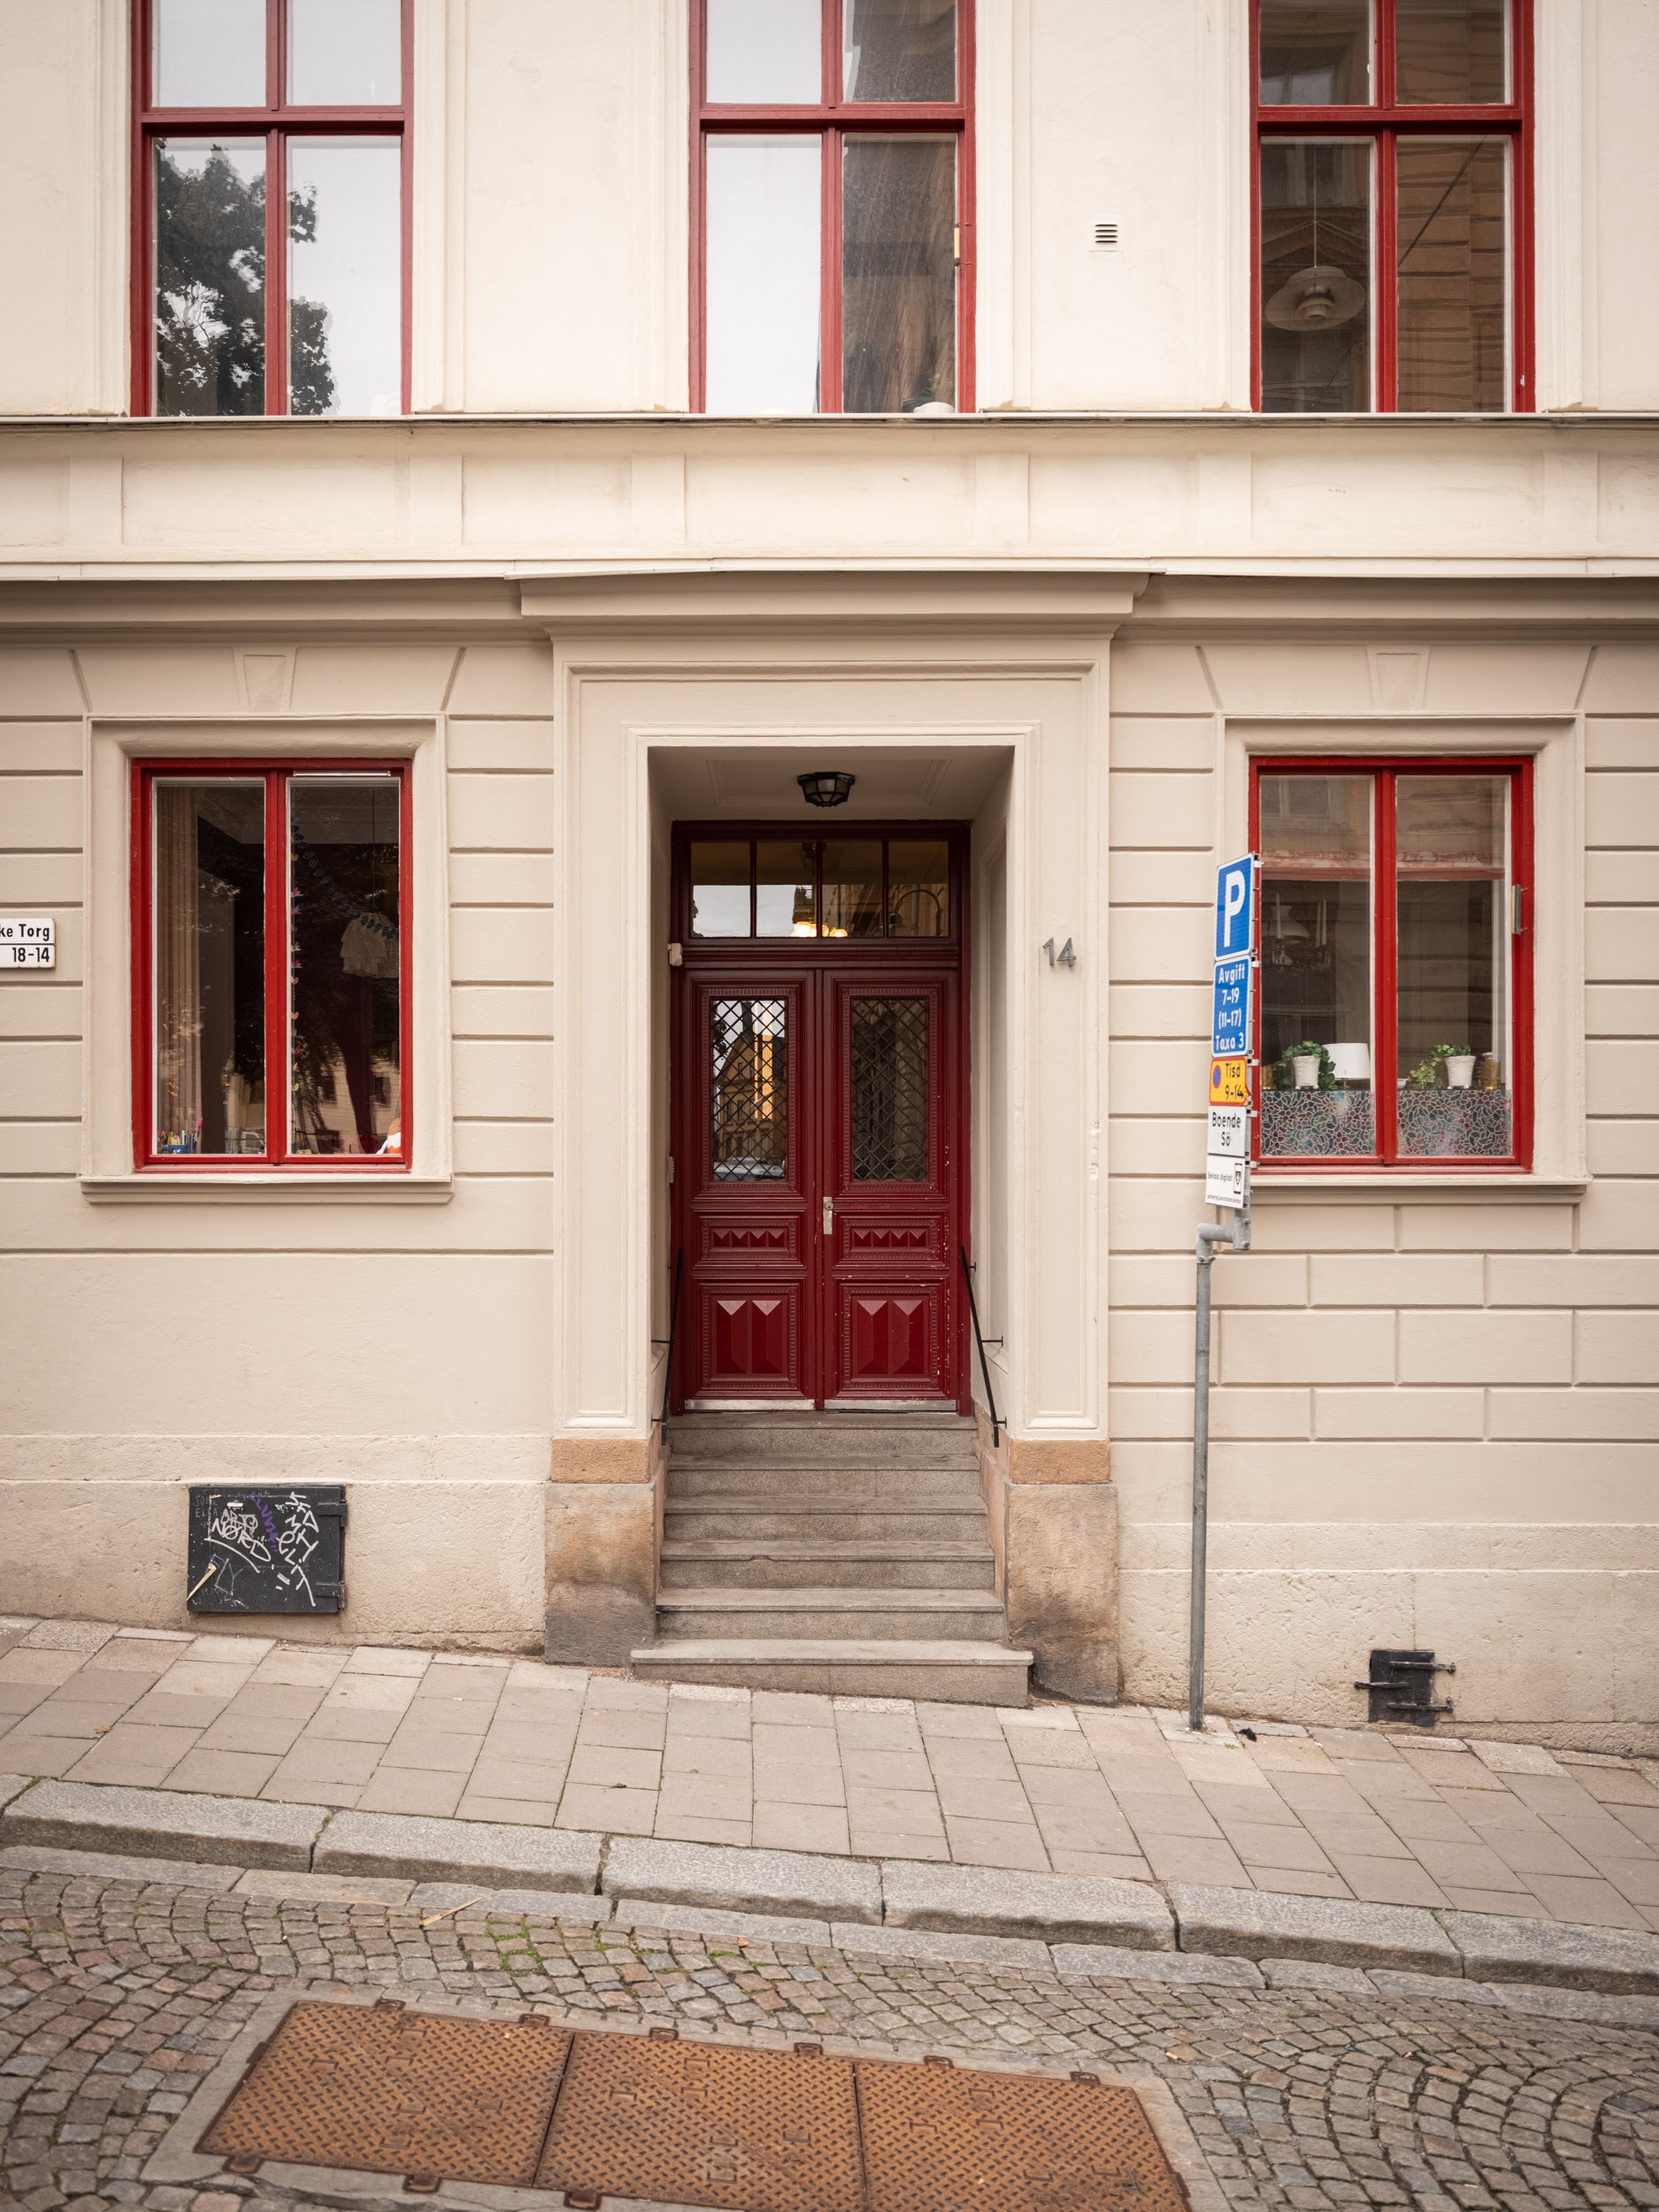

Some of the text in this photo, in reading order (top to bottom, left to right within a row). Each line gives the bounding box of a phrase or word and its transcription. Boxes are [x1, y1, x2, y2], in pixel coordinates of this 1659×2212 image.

[1224, 870, 1246, 948] P
[19, 924, 50, 941] Torg
[12, 947, 50, 963] 18-14
[1042, 937, 1076, 967] 14
[1217, 963, 1246, 986] Avgift
[1222, 987, 1240, 1005] 7-19
[1217, 1008, 1242, 1029] (11-17)
[1215, 1033, 1244, 1051] Taxa 3
[1225, 1063, 1241, 1078] Tisd
[1225, 1085, 1244, 1100] 9-14
[1212, 1111, 1241, 1128] Boende
[1221, 1132, 1232, 1147] Sö
